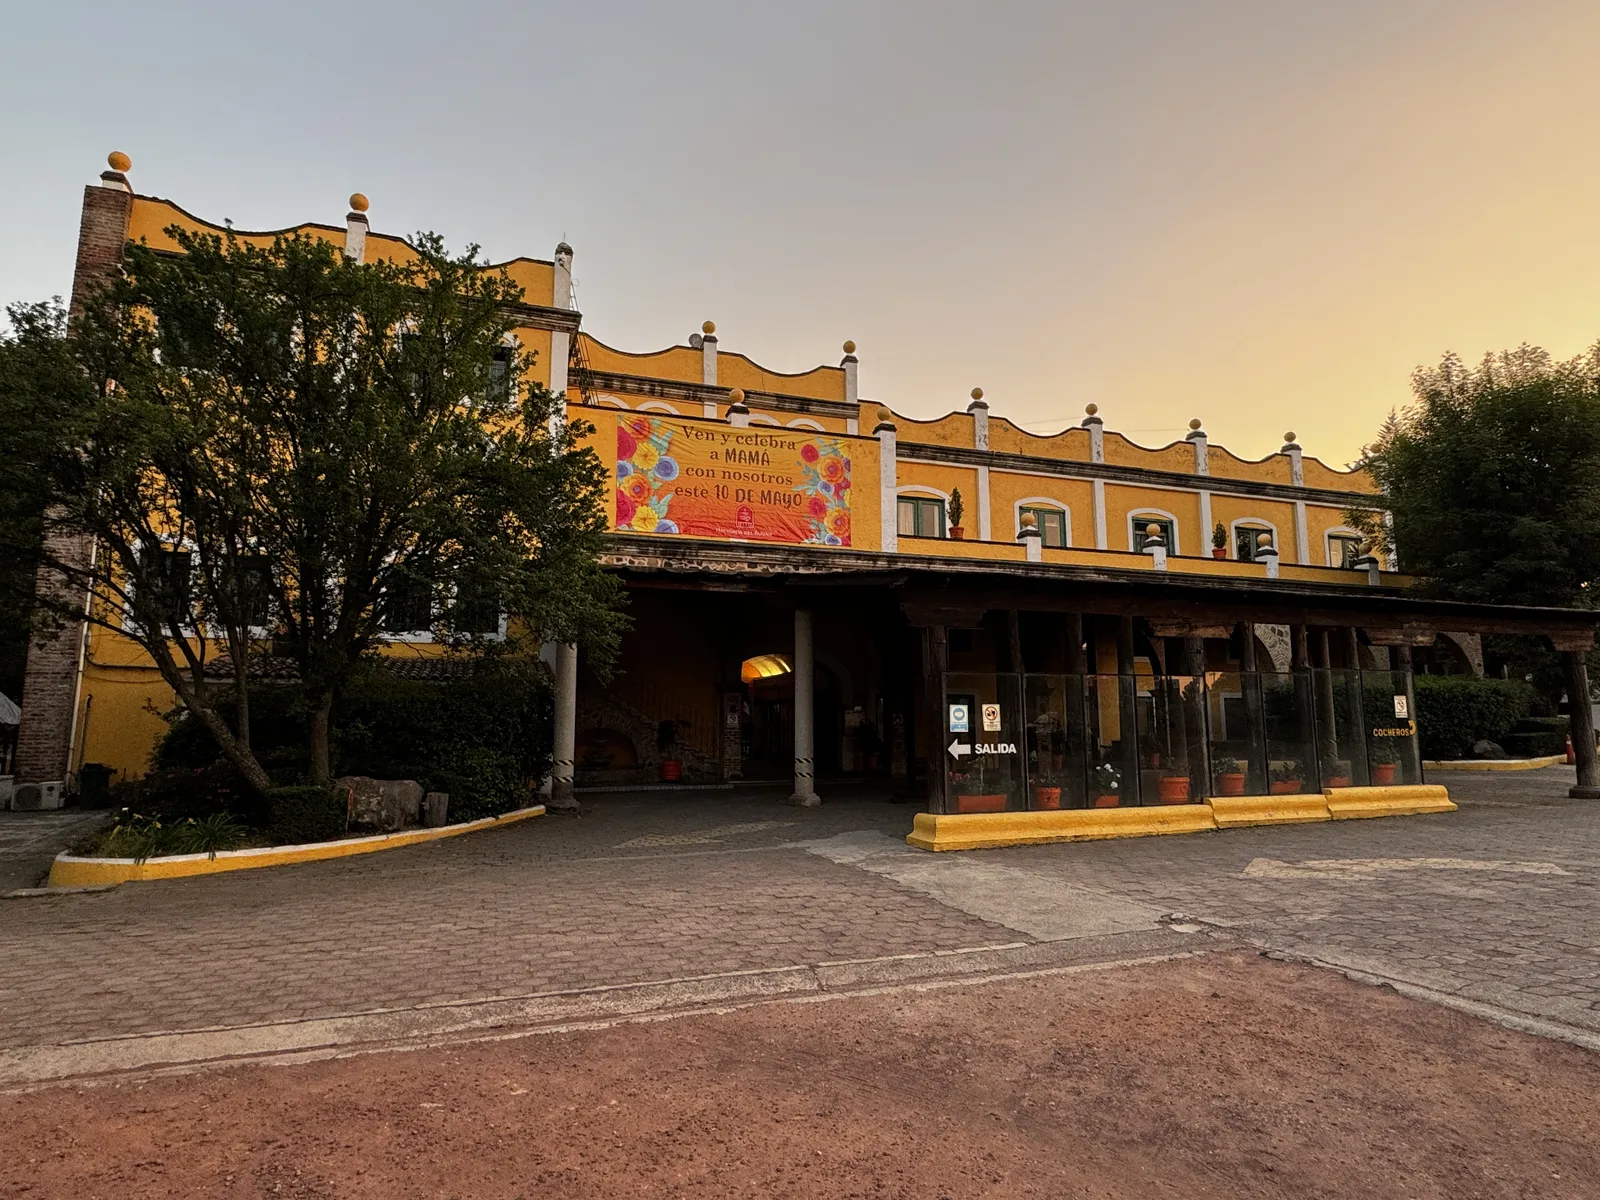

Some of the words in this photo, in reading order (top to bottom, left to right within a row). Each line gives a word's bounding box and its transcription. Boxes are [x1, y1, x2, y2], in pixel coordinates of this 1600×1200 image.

[681, 425, 715, 441] Ven
[720, 433, 730, 446] y
[735, 433, 796, 450] celebra
[709, 450, 719, 461] a
[725, 447, 770, 466] MAMÁ
[685, 466, 716, 478] con
[721, 470, 793, 486] nosotros
[674, 486, 709, 498] este
[714, 484, 729, 500] 10
[735, 488, 755, 503] DE
[760, 489, 802, 509] MAYO
[1373, 728, 1410, 737] COCHEROS
[974, 743, 1017, 754] SALIDA
